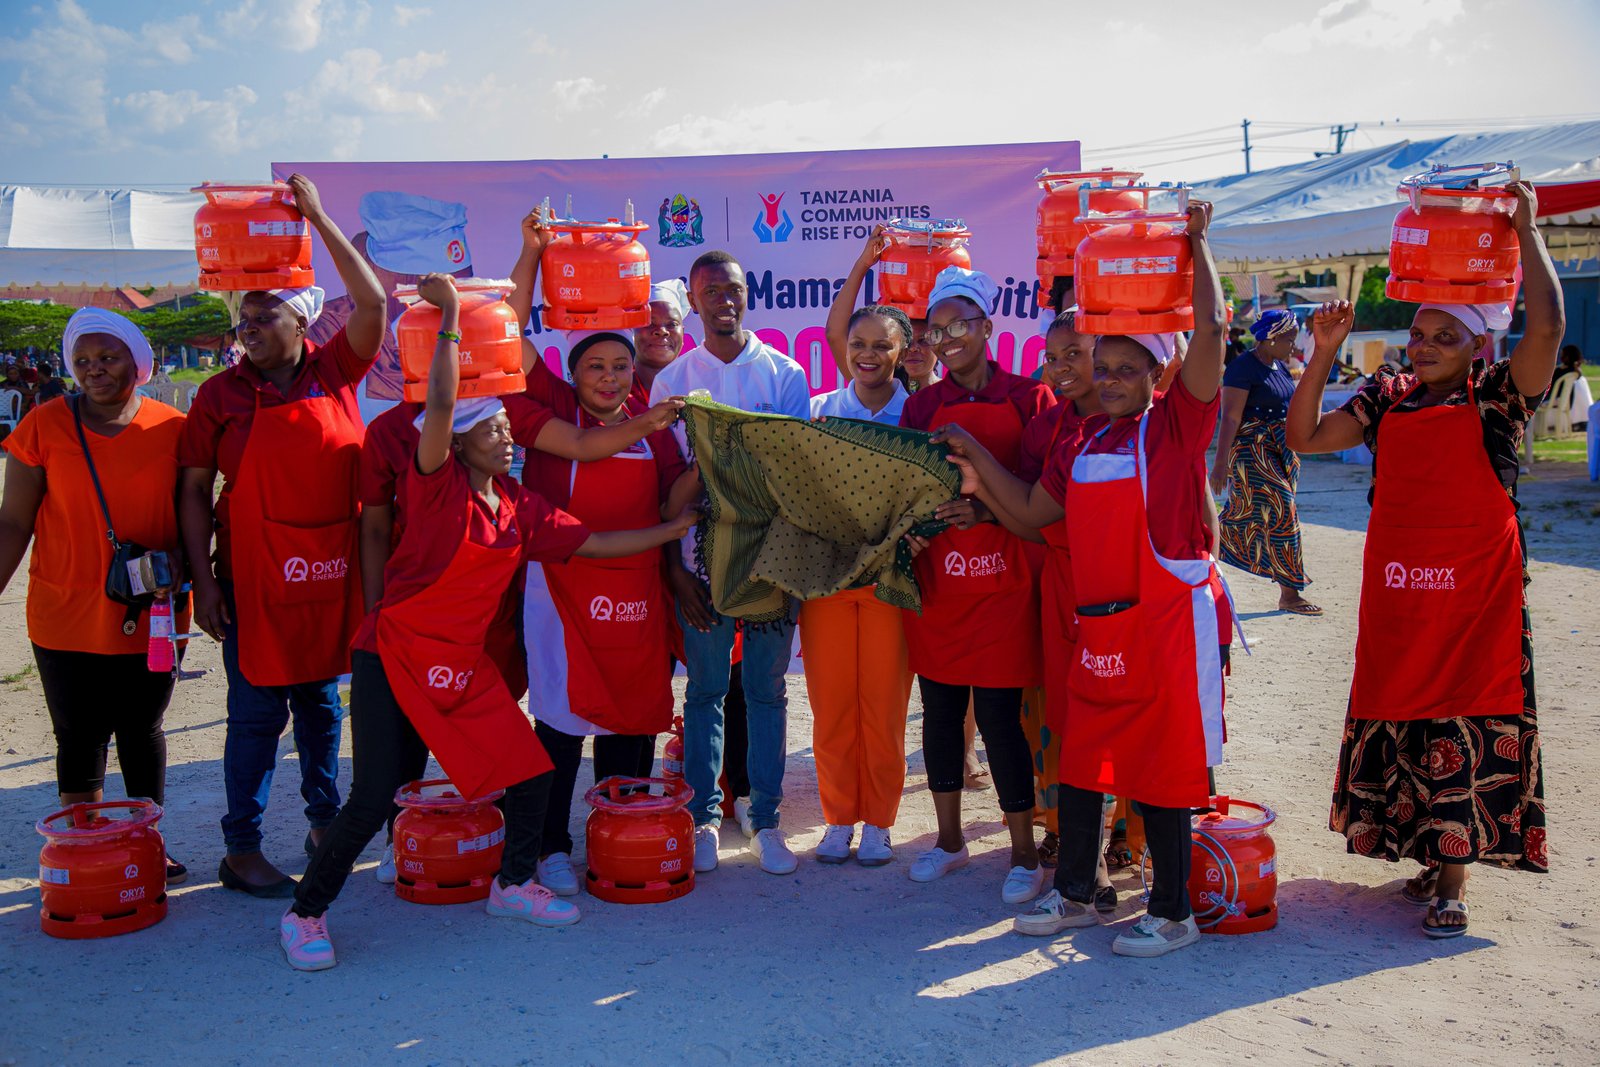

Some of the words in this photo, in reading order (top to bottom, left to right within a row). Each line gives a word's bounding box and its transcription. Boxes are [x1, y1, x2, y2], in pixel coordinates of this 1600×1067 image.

[800, 188, 895, 205] TANZANIA
[801, 205, 931, 223] COMMUNITIES
[801, 226, 839, 241] RISE
[201, 246, 219, 257] ORYX
[1468, 258, 1495, 268] ORYX
[559, 287, 582, 297] ORYX
[311, 556, 348, 575] ORYX
[1410, 567, 1455, 582] ORYX
[1410, 581, 1455, 590] ENERGIES
[616, 600, 648, 615] ORYX
[1090, 652, 1125, 669] ORYX
[1092, 666, 1126, 678] NERGIES
[404, 859, 424, 871] ORYX
[660, 858, 682, 871] ORYX
[120, 885, 145, 899] ORYX
